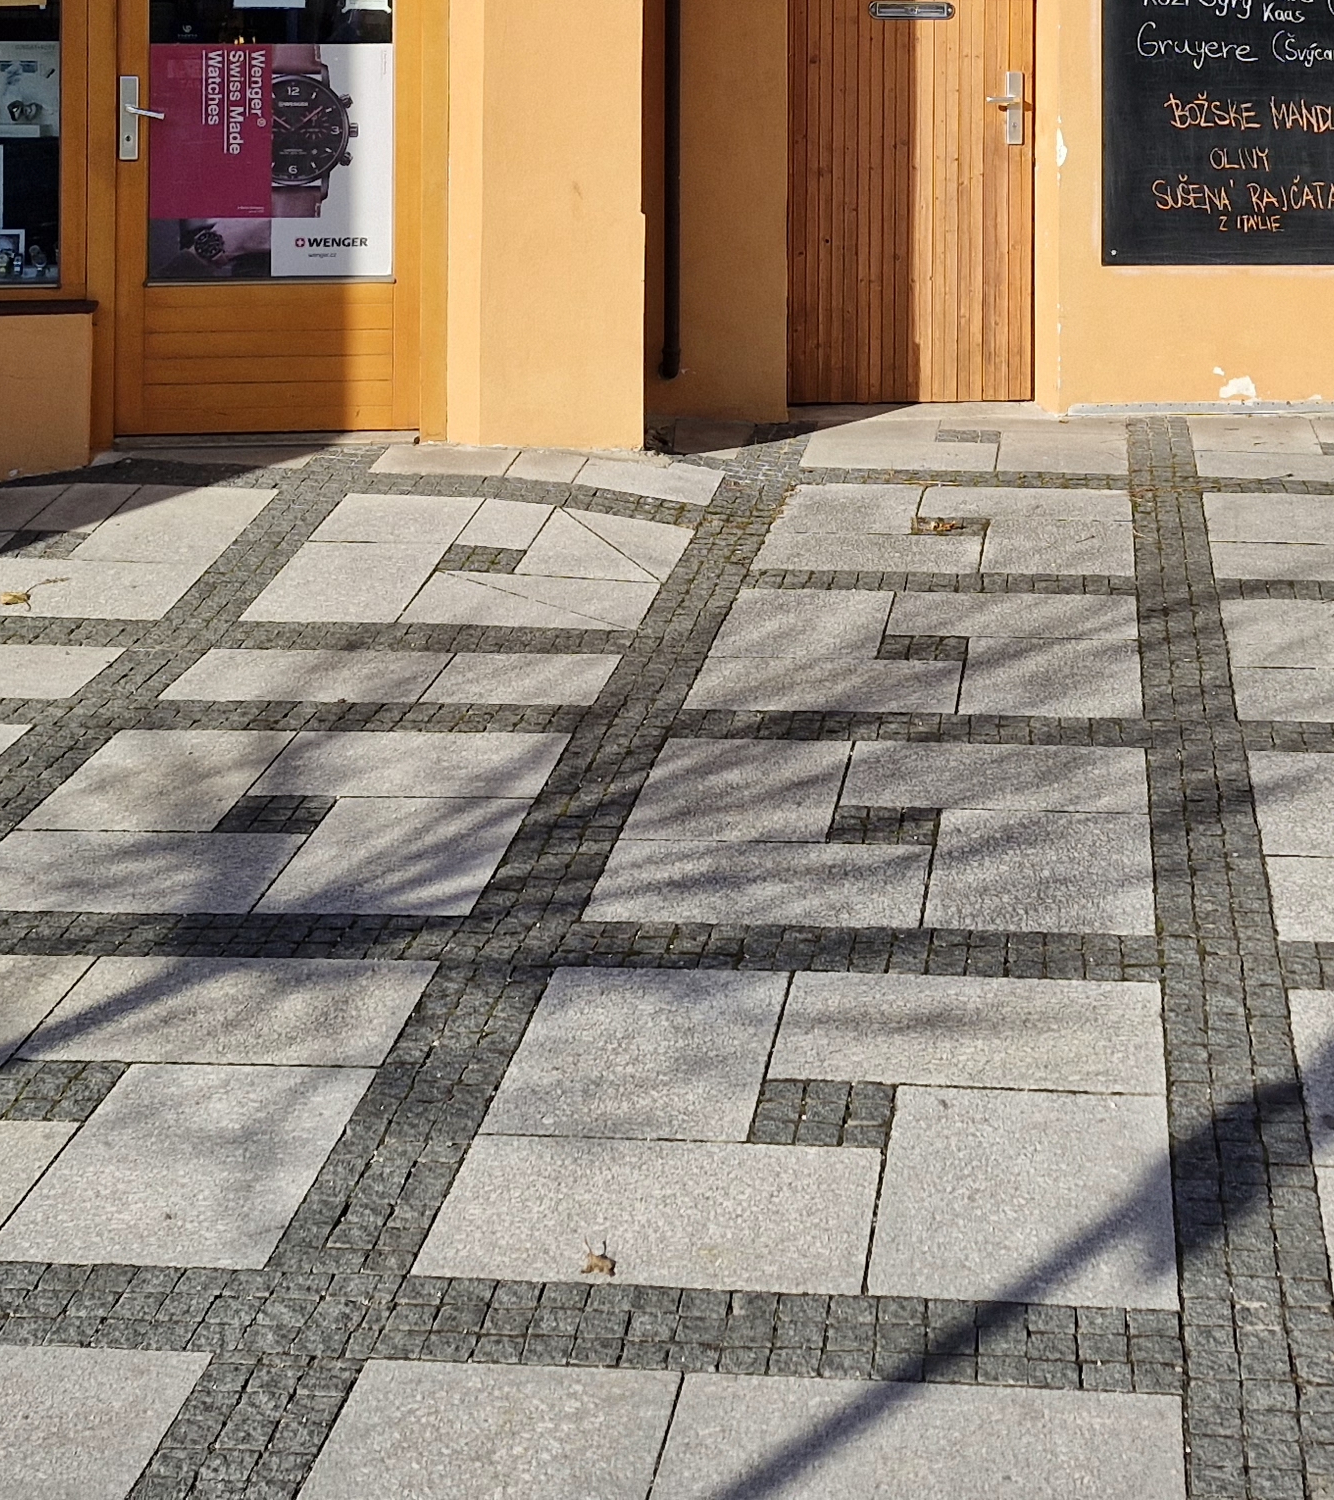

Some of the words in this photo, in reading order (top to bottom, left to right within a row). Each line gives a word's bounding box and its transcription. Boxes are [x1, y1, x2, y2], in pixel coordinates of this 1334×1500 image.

[1262, 2, 1305, 23] Kaas
[1137, 21, 1259, 70] Gruyere
[208, 49, 223, 125] Watches
[229, 50, 244, 101] Swiss
[287, 87, 300, 96] 12
[229, 105, 244, 154] Made
[331, 126, 340, 135] 3
[288, 165, 298, 174] 6
[1210, 146, 1270, 171] OLIVY
[308, 237, 368, 248] WENGER
